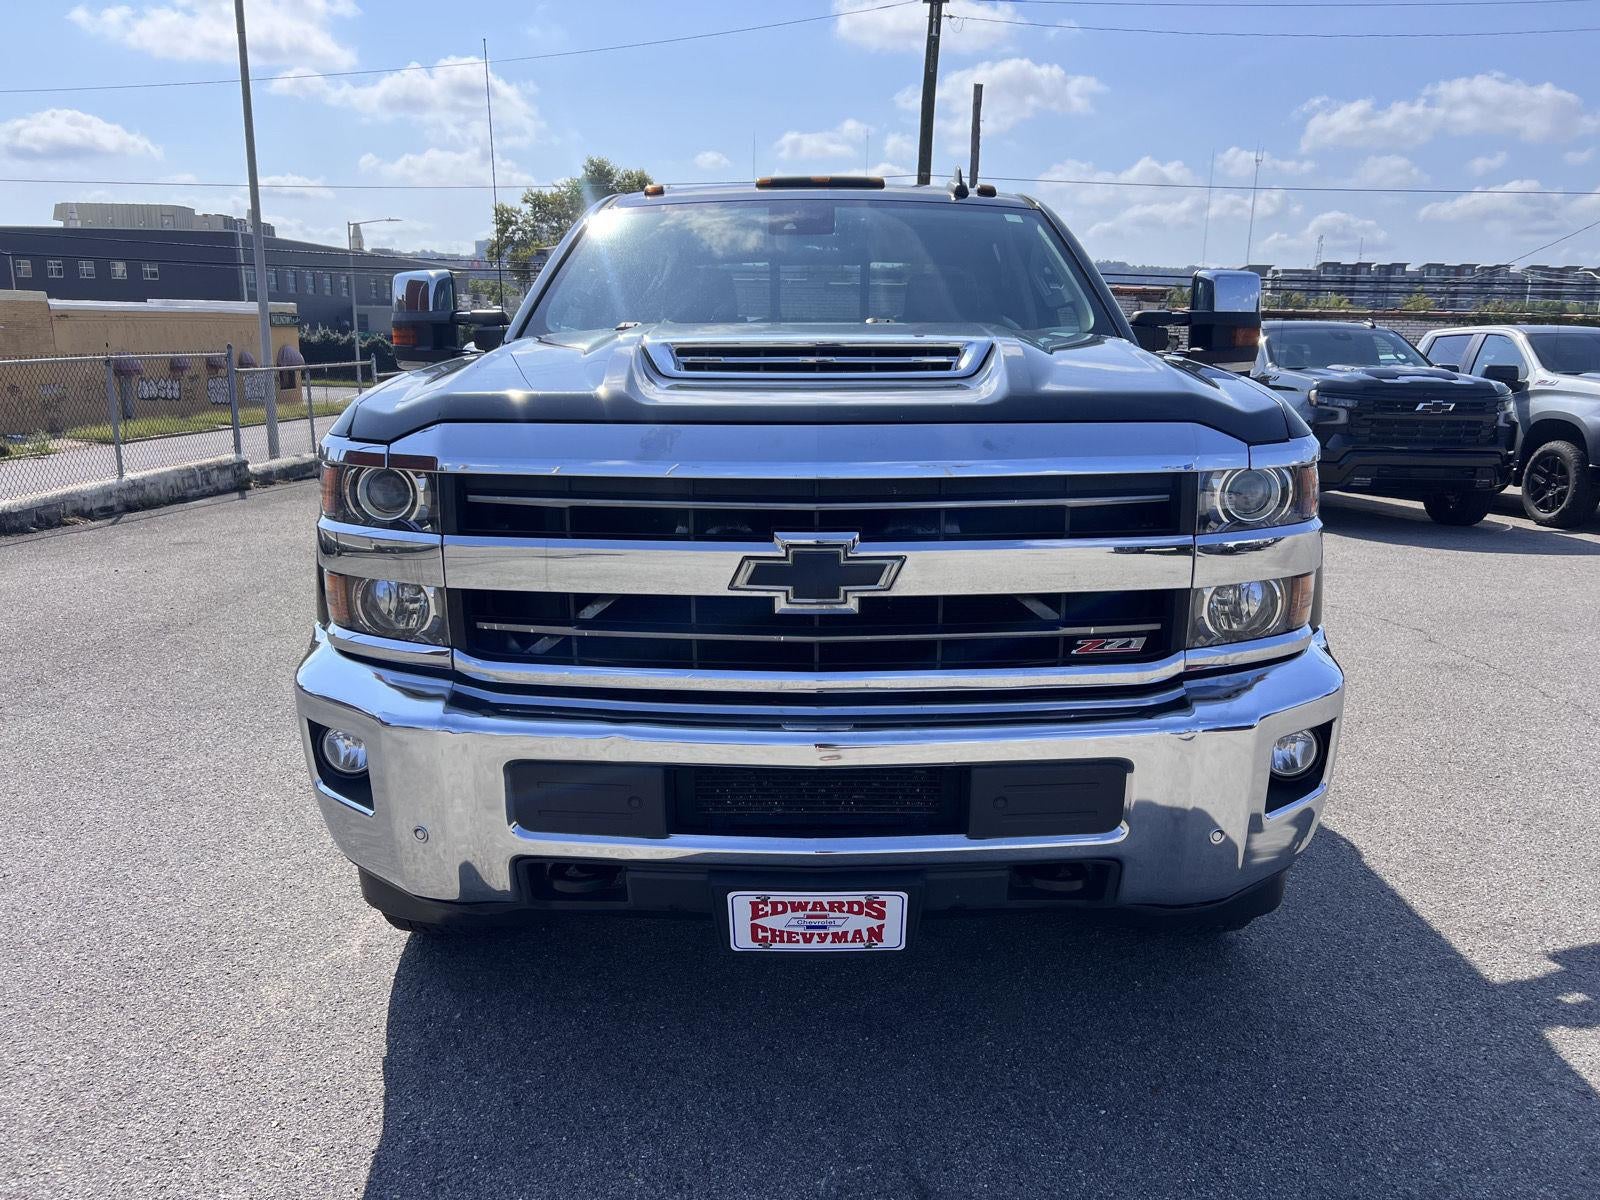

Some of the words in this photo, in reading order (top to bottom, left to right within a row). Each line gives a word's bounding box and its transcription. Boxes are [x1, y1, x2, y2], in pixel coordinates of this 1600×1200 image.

[1071, 636, 1147, 654] Z71
[749, 901, 886, 921] EDWARDS
[796, 918, 836, 926] Chevrolet
[750, 923, 885, 943] CHEVYMAN
